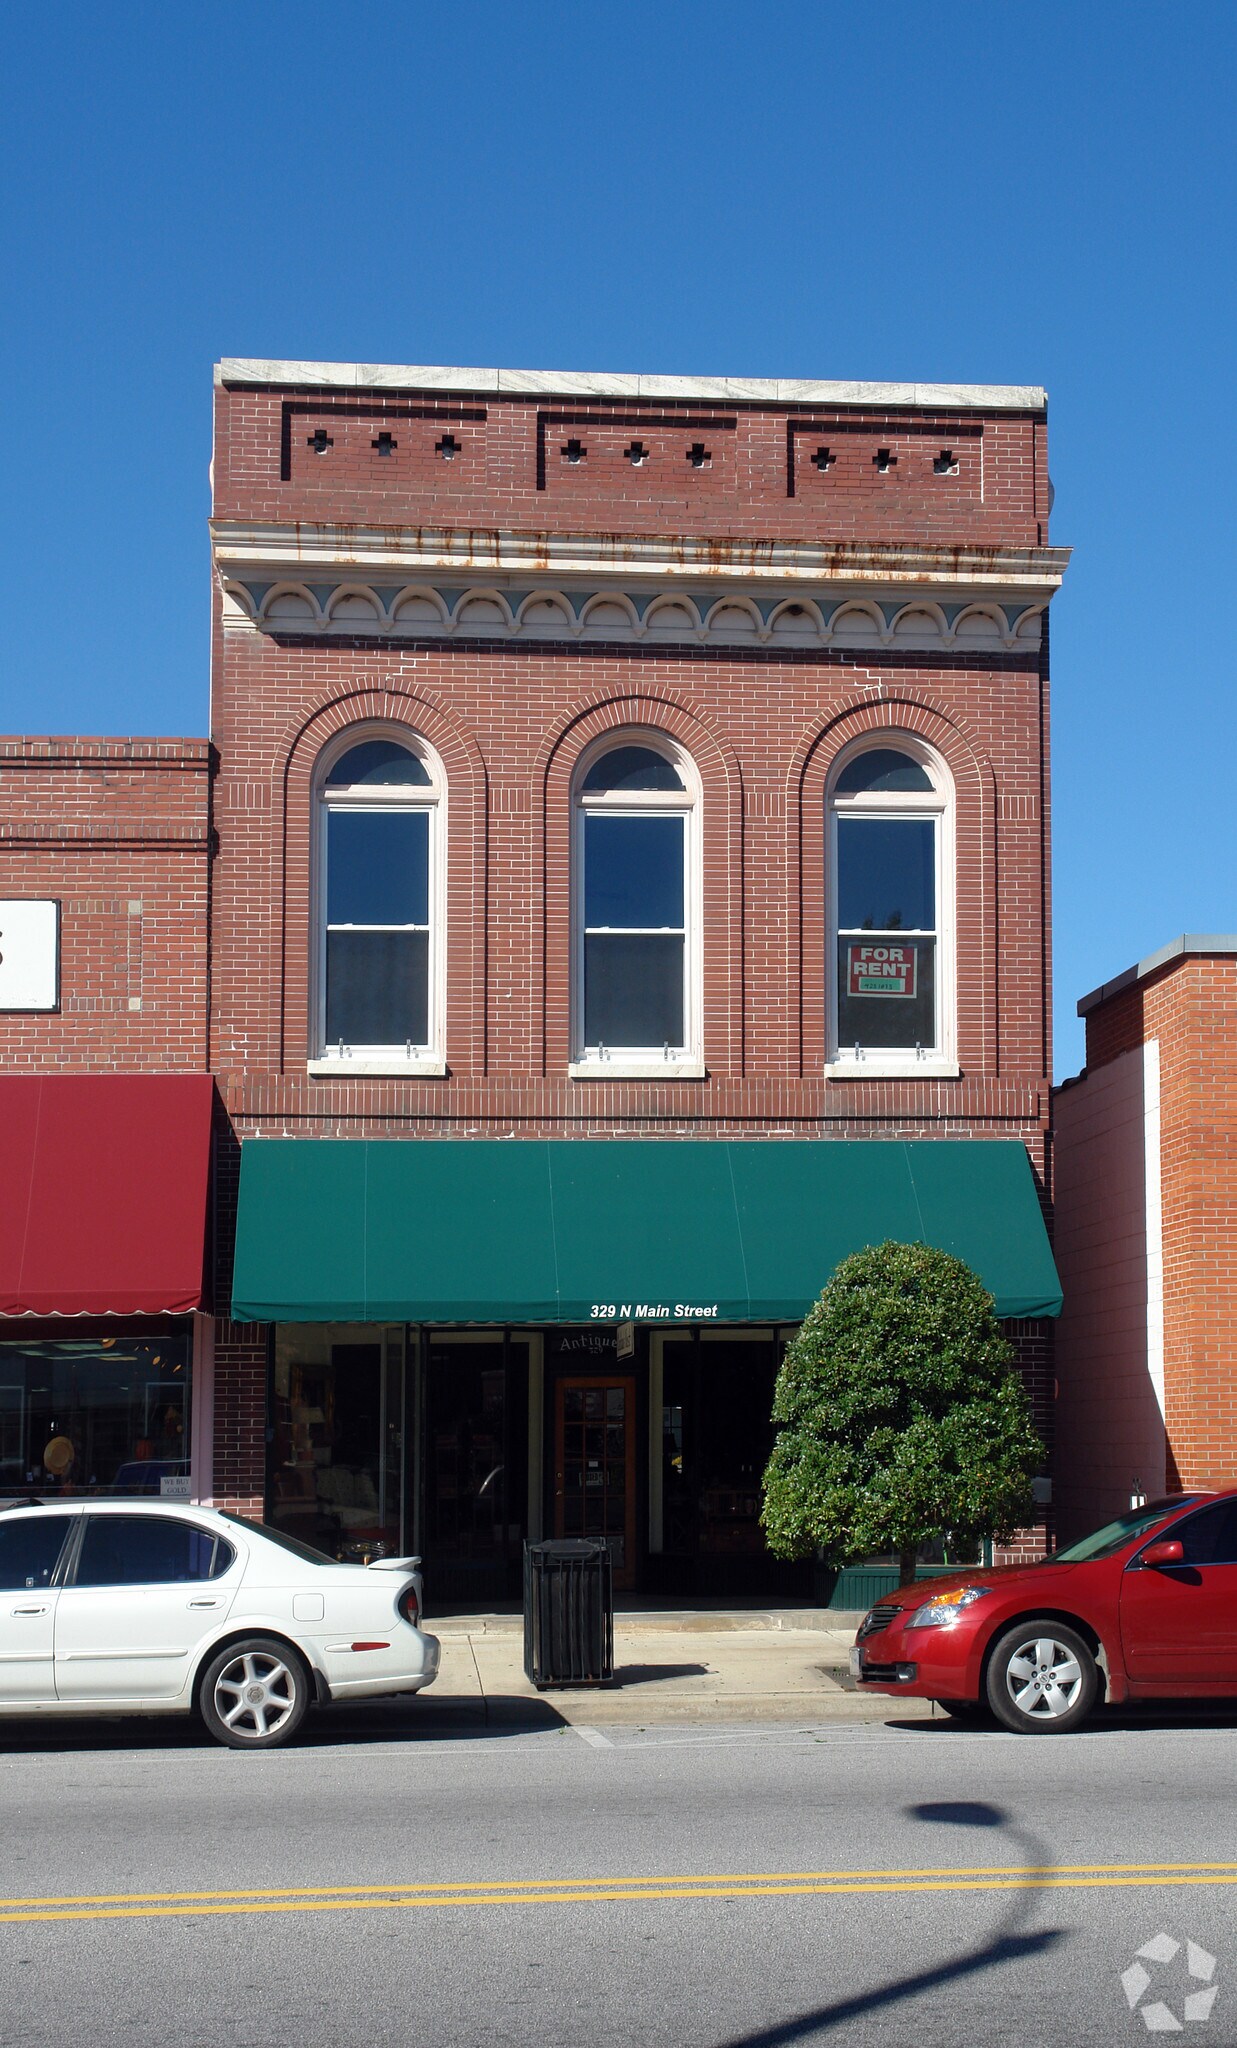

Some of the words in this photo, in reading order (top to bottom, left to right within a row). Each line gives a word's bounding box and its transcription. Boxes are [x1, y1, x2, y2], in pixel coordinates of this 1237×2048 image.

[861, 948, 903, 961] FOR
[854, 962, 911, 976] RENT
[590, 1304, 616, 1318] 329
[620, 1305, 632, 1318] N
[635, 1304, 670, 1318] Main
[673, 1304, 718, 1318] Street
[560, 1333, 617, 1351] Antique
